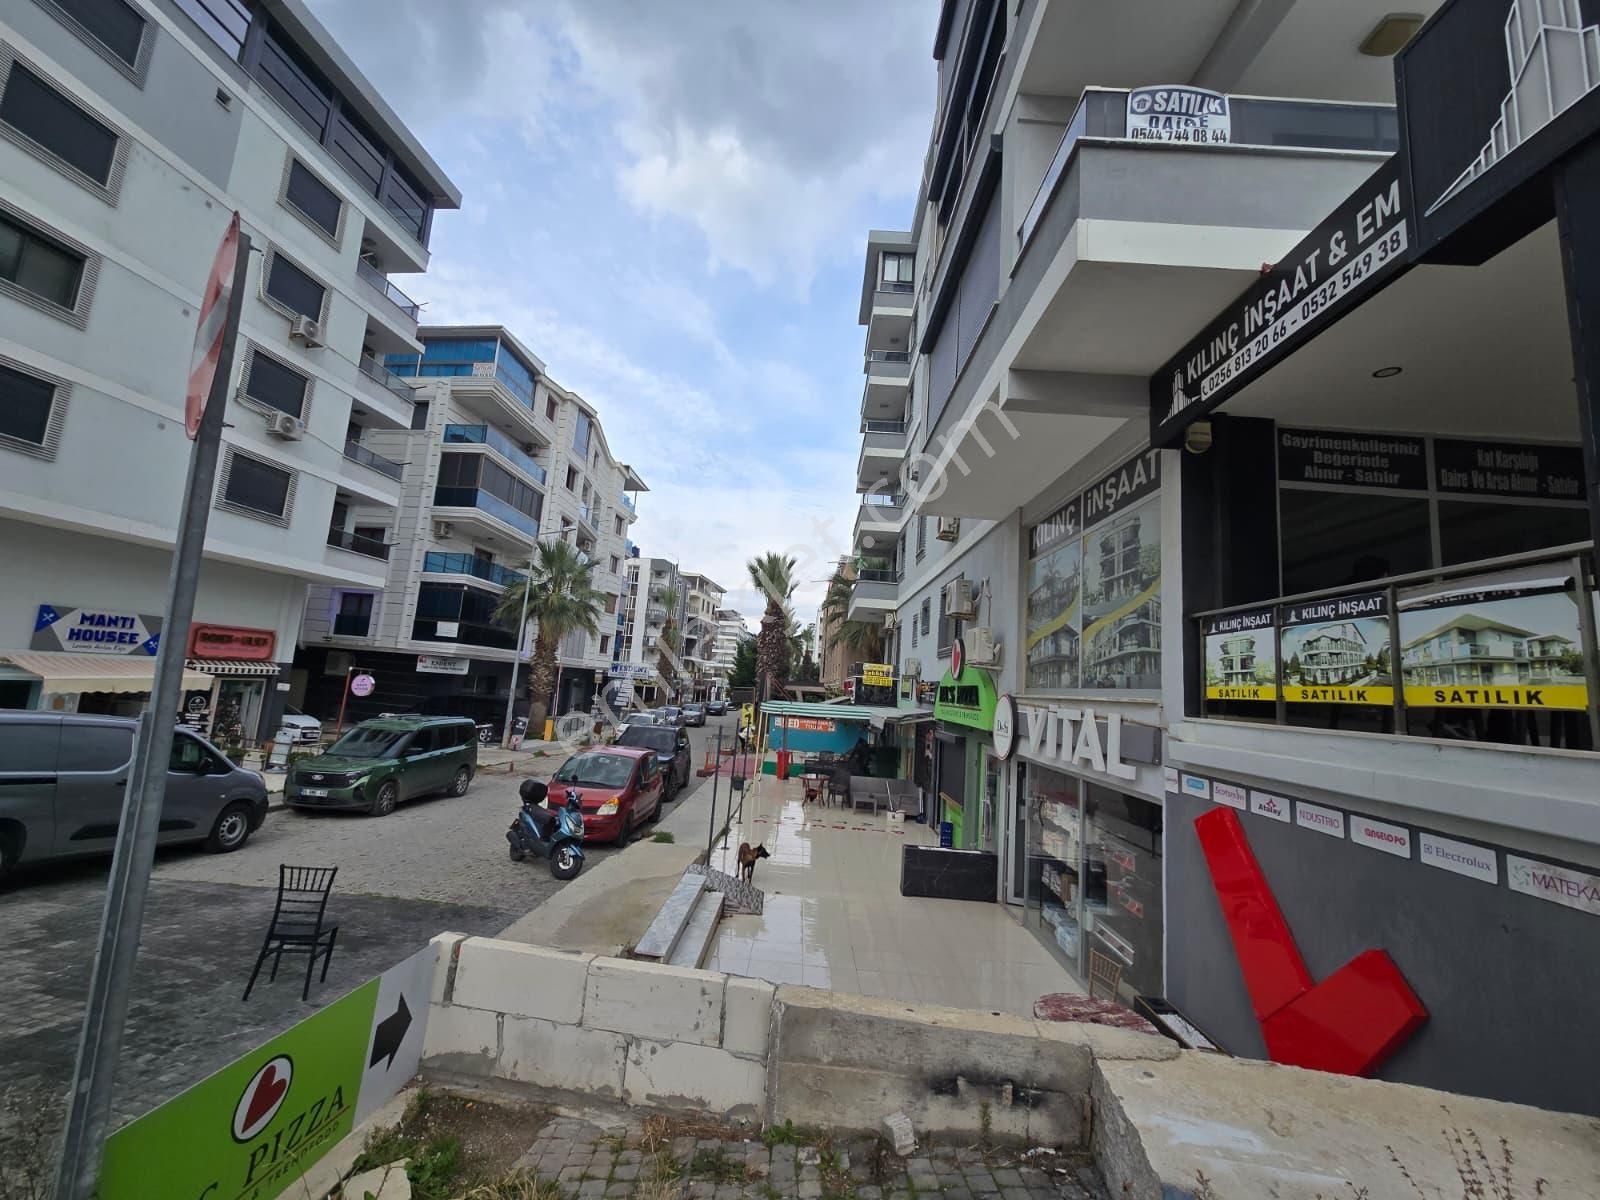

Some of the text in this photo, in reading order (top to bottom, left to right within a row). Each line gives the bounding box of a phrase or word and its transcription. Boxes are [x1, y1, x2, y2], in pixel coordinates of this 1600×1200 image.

[1154, 91, 1224, 116] SATILIK
[1131, 127, 1227, 143] 0544 744 08 44
[1186, 322, 1240, 386] KILINÇ
[1243, 248, 1321, 337] İNŞAAT
[1327, 229, 1349, 266] &
[1207, 361, 1233, 395] 0256
[1233, 348, 1254, 376] 813
[1254, 335, 1271, 359] 20
[1272, 320, 1288, 347] 66
[1301, 286, 1338, 323] 0532
[1341, 254, 1372, 292] 549
[1377, 229, 1402, 263] 38
[1032, 448, 1162, 551] KILINÇ İNŞAAT
[79, 612, 136, 629] MANTI
[1301, 596, 1384, 624] KILINÇ İNŞAAT
[67, 627, 140, 645] HOUSEE
[1219, 612, 1272, 636] KILINÇ İNŞAAT
[1218, 689, 1260, 699] SATILIK
[1300, 689, 1369, 702] SATILIK
[1434, 689, 1546, 706] SATILIK
[1258, 803, 1282, 817] Atalay
[1435, 847, 1493, 873] Electrolux
[243, 1085, 345, 1189] PIZZA
